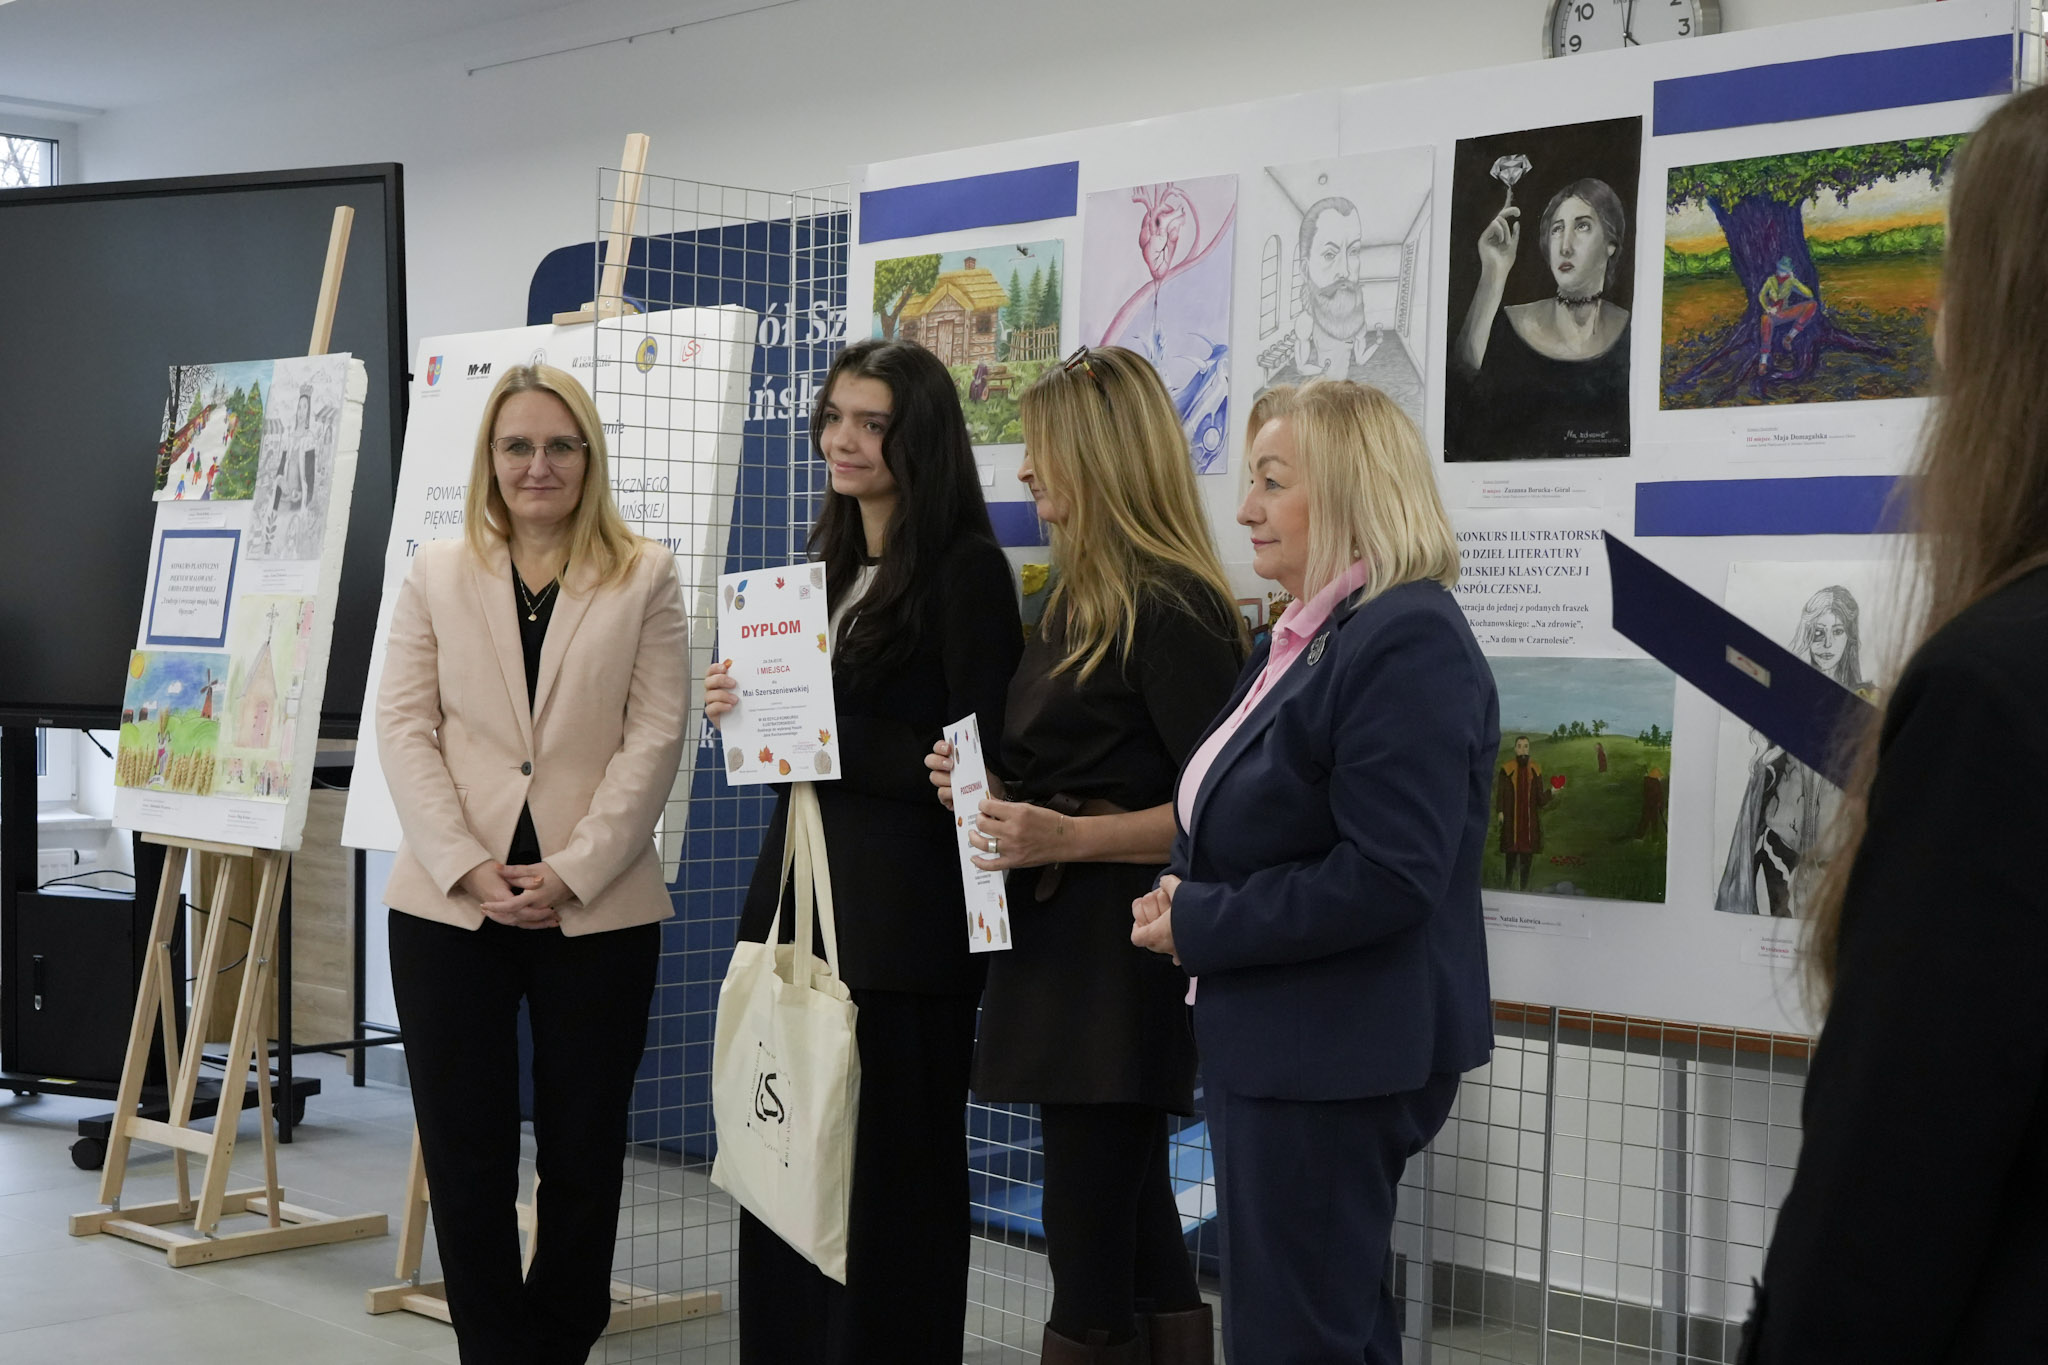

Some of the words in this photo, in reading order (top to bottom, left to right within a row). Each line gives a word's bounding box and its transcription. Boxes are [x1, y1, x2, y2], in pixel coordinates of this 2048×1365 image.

[1574, 2, 1594, 22] 10
[1678, 18, 1690, 36] 3
[1569, 34, 1582, 52] 9
[610, 476, 669, 494] TYCZNEGO
[1456, 531, 1507, 542] KONKURS
[1510, 530, 1604, 541] ILUSTRATORSKI
[1473, 549, 1503, 559] DZIEŁ
[1508, 548, 1580, 559] LITERATURY
[1460, 566, 1505, 577] OLSKIEJ
[1508, 566, 1582, 576] KLASYCZNEJ
[1454, 581, 1541, 594] WSPÓŁCZESNEJ.
[1460, 604, 1484, 613] stracja
[1496, 604, 1518, 613] jednej
[1525, 604, 1560, 613] podanych
[1562, 604, 1589, 612] fraszek
[742, 620, 801, 639] DYPLOM
[1469, 620, 1529, 629] Kochanowskiego:
[761, 665, 791, 674] MIEJSCA
